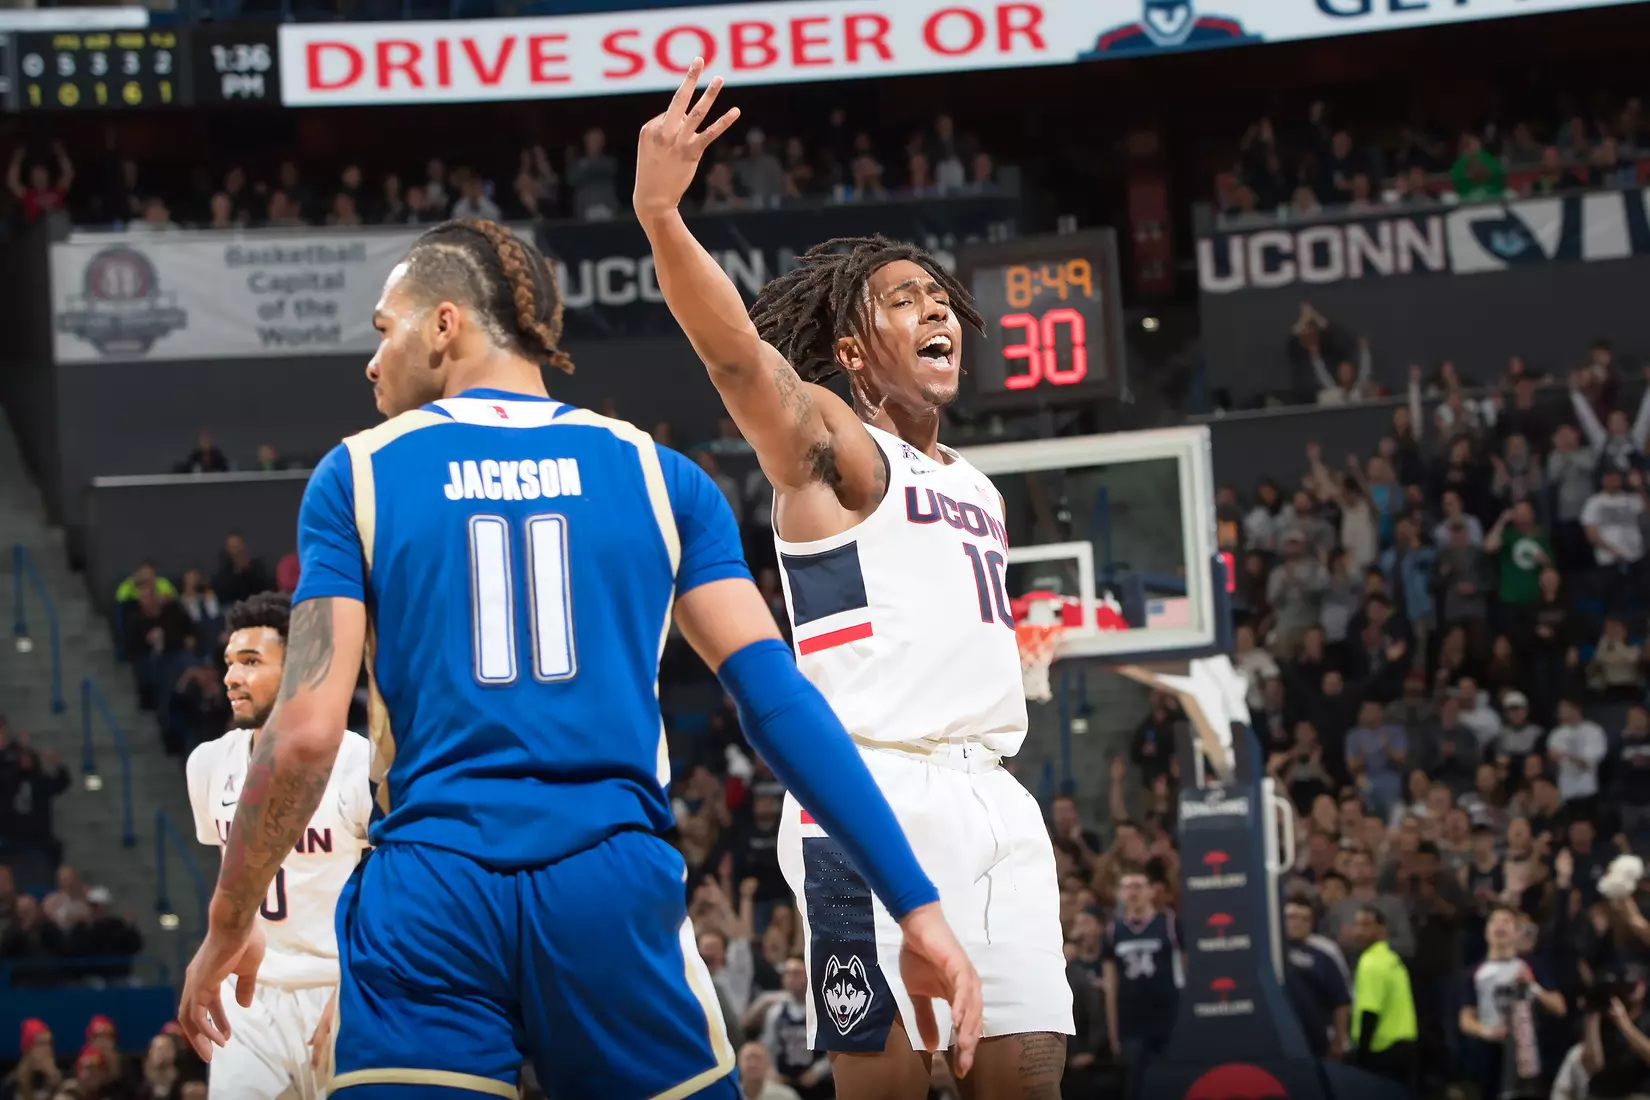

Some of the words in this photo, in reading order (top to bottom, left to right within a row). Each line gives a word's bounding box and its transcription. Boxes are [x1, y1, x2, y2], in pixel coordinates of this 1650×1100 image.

[306, 33, 573, 92] DRIVE
[601, 12, 894, 79] SOBER
[922, 3, 1046, 57] OR
[221, 73, 265, 99] PM
[556, 249, 766, 309] UCN
[1197, 215, 1446, 292] UCONN
[257, 298, 284, 320] of
[293, 298, 338, 320] the
[1004, 259, 1092, 308] 8:49
[257, 323, 342, 347] World
[1000, 308, 1088, 390] 30
[444, 458, 582, 500] JACKSON
[467, 512, 579, 684] 11
